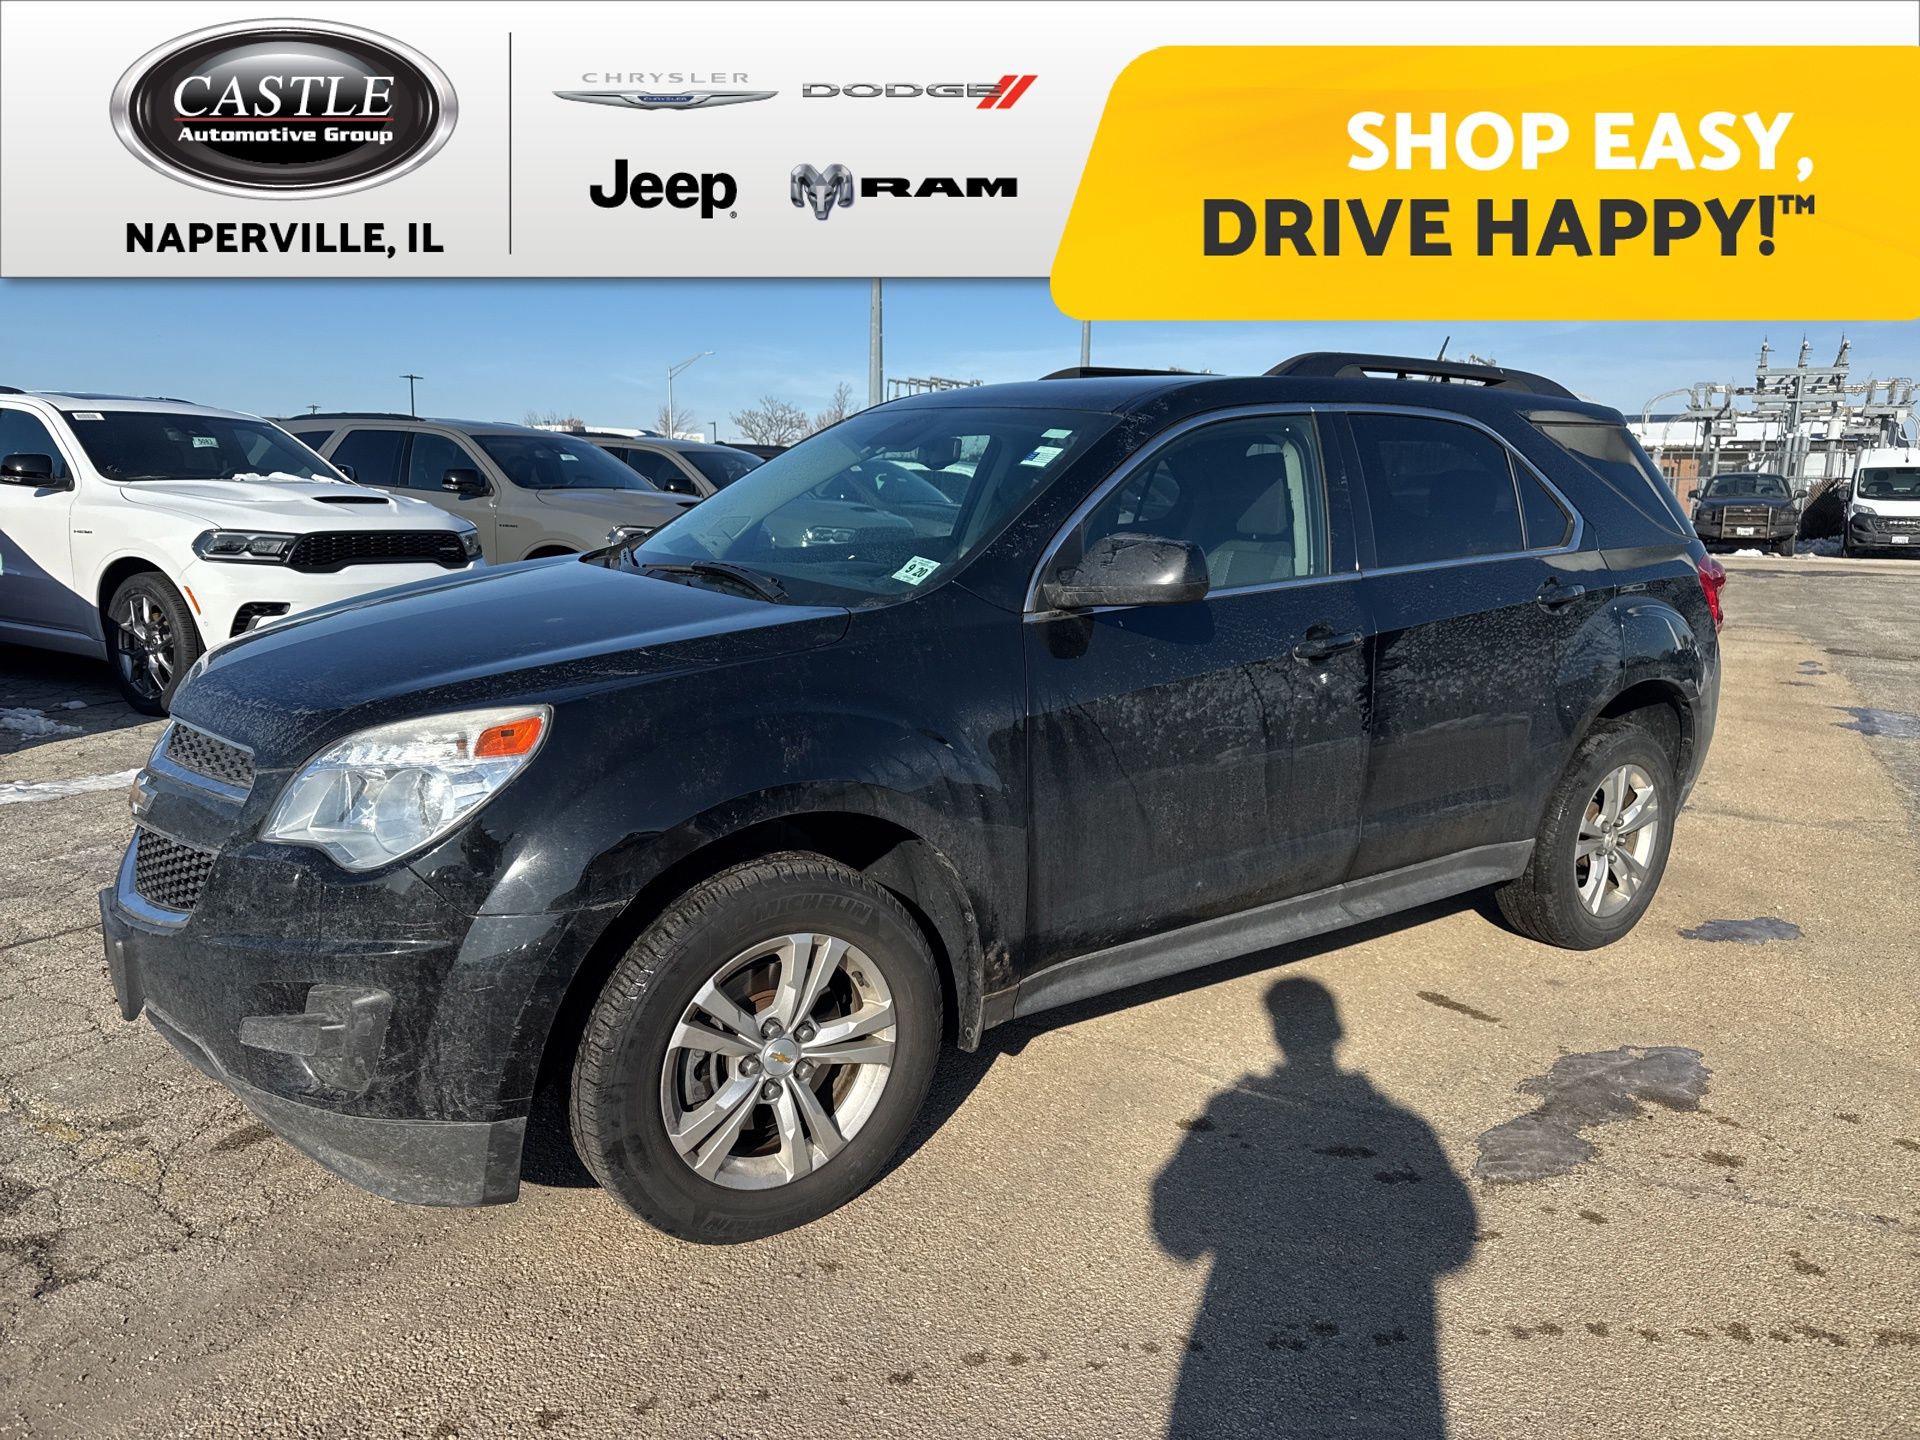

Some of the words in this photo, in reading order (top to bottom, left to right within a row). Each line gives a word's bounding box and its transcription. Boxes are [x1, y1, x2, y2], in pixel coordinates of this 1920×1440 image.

[905, 563, 917, 573] 9
[911, 567, 929, 578] 20
[755, 893, 874, 926] MICHELIN
